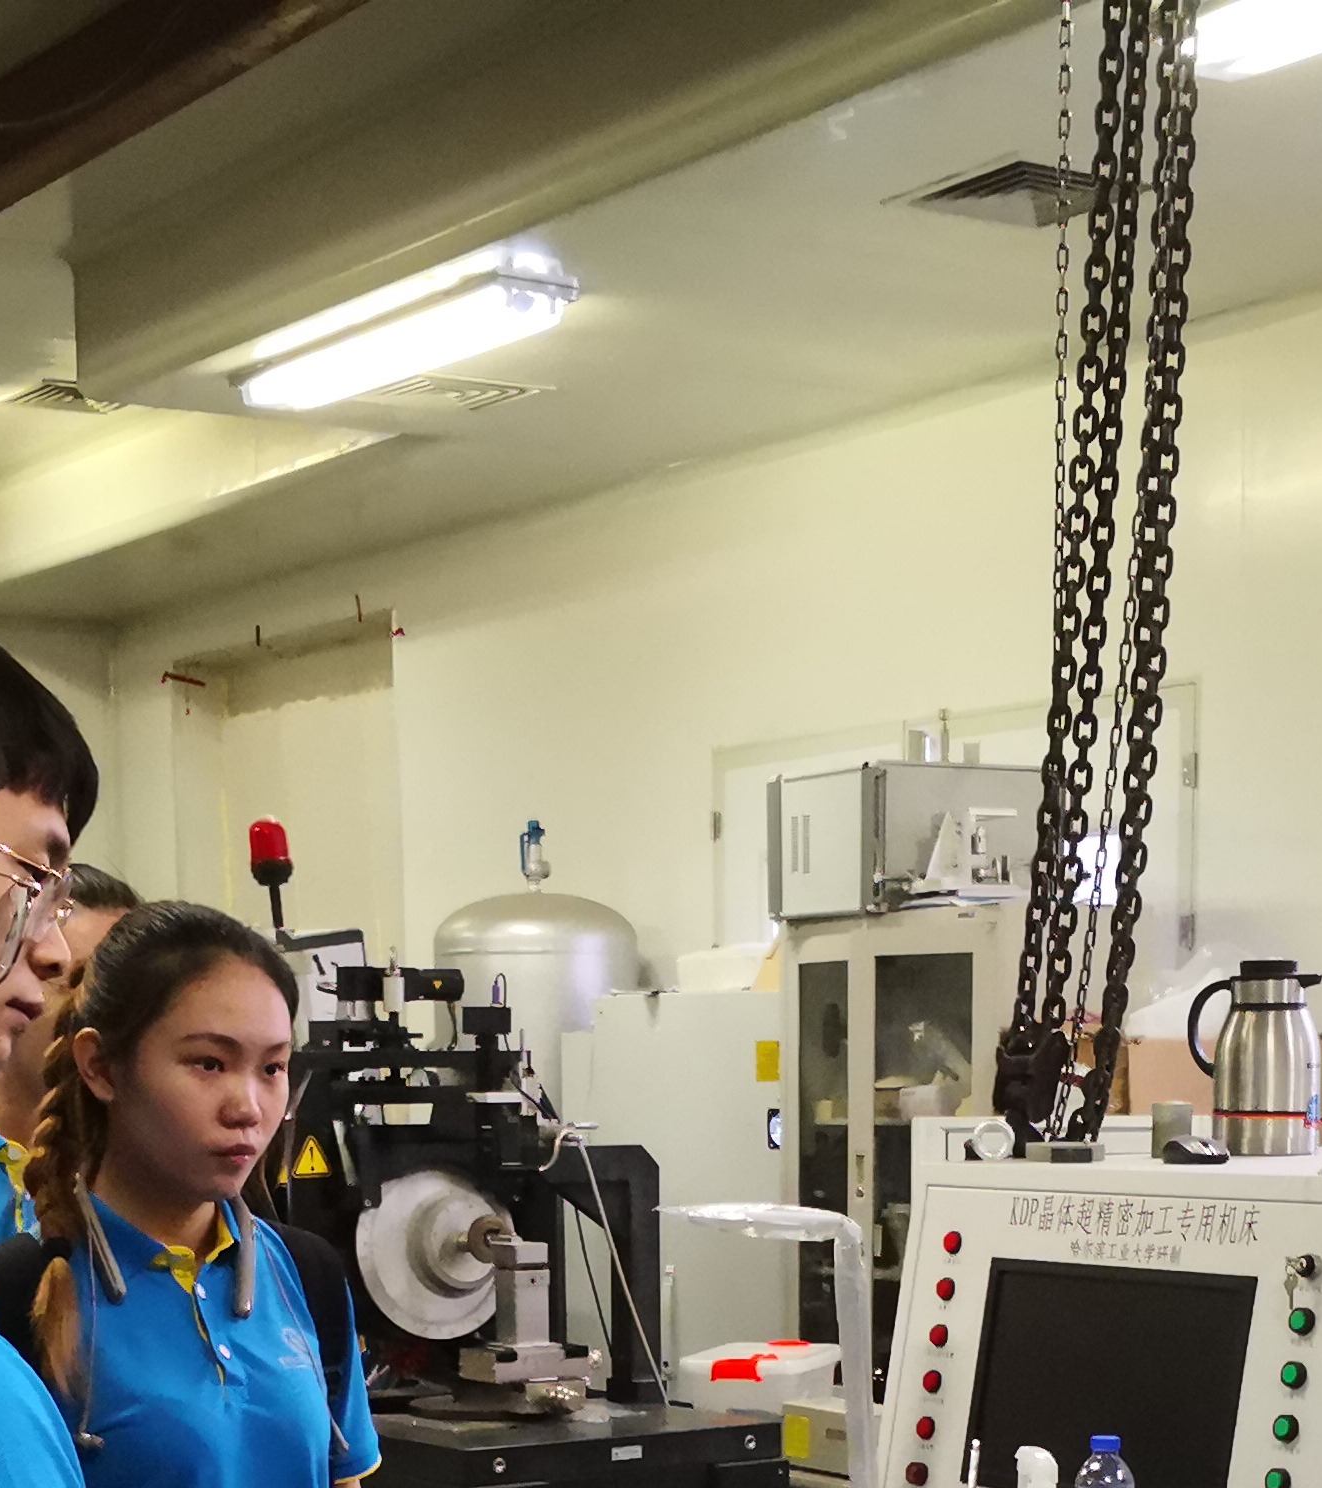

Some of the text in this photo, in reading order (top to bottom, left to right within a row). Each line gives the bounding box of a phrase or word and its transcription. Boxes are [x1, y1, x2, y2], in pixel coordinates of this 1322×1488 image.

[1009, 1195, 1260, 1246] KDP晶体超精密加工专用机床
